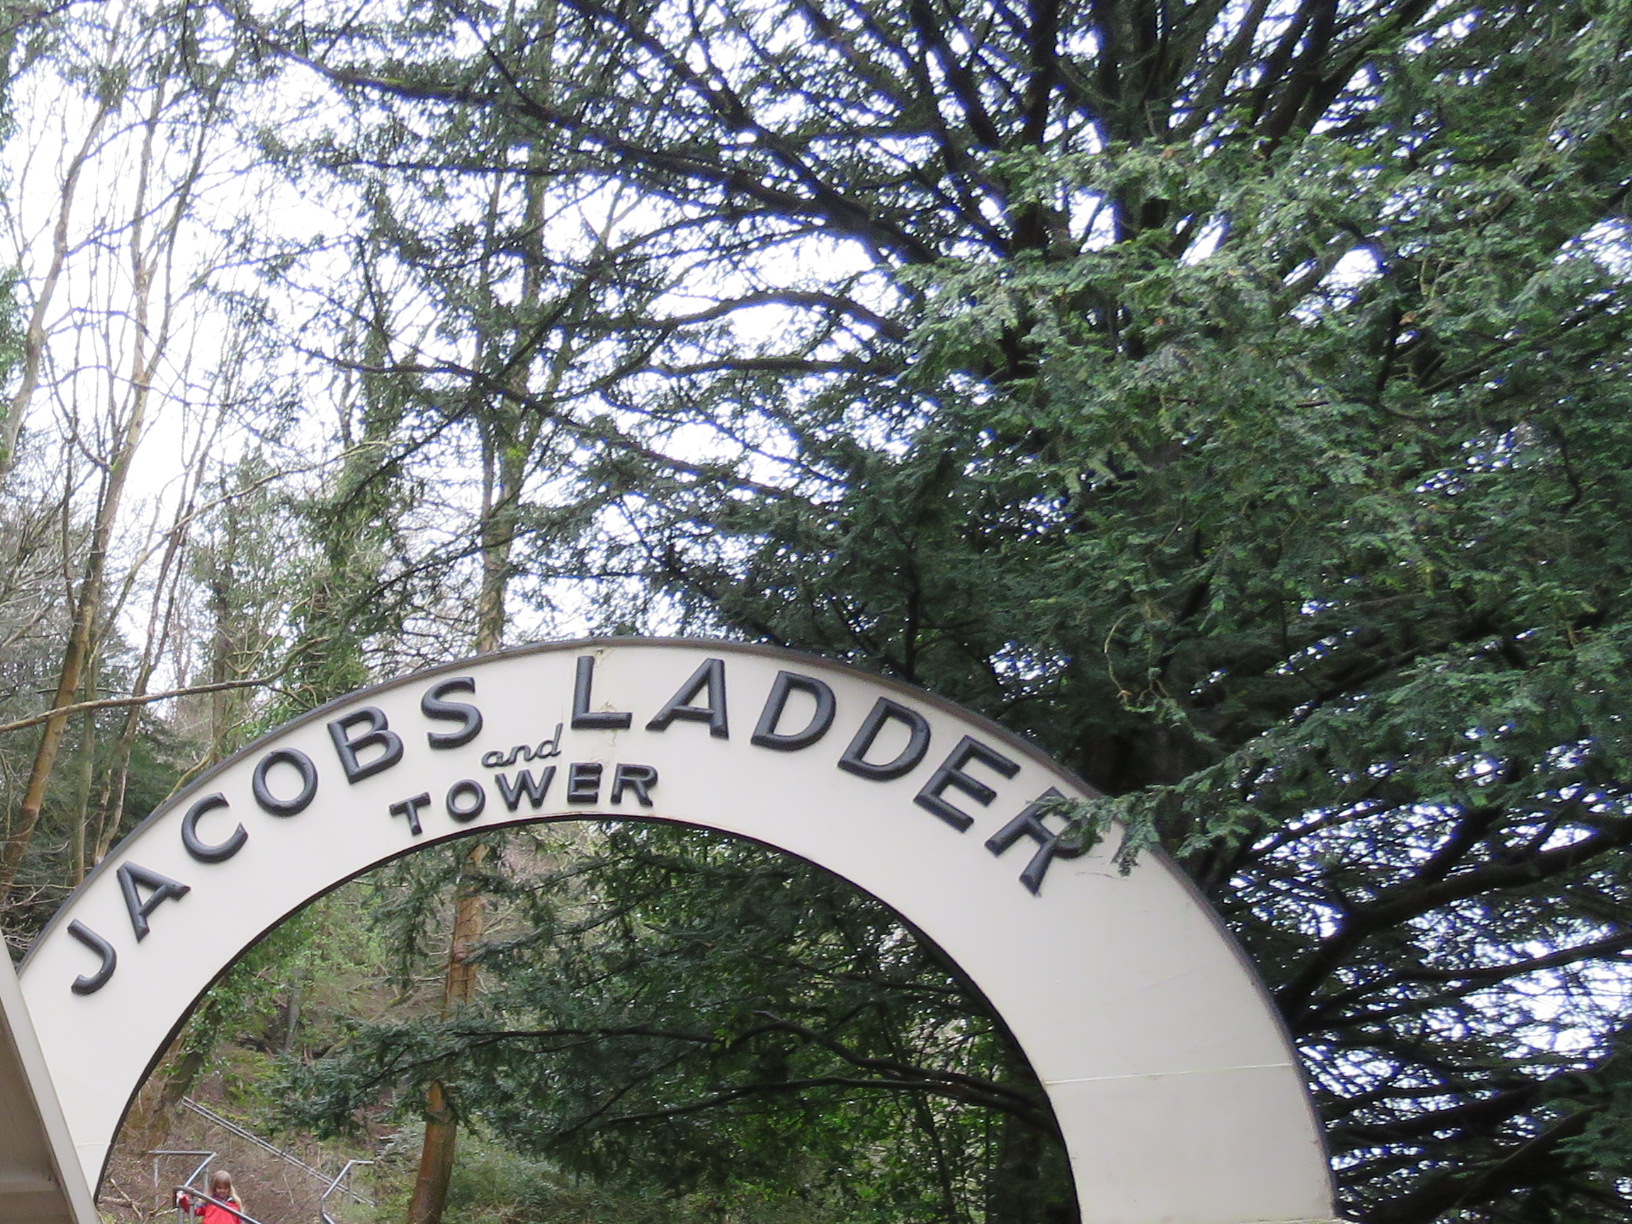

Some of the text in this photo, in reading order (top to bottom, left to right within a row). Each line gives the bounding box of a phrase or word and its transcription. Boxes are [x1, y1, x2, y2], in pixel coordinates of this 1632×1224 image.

[483, 722, 563, 771] and
[67, 654, 1104, 994] JACOBS LADDER
[389, 761, 660, 836] TOWER
